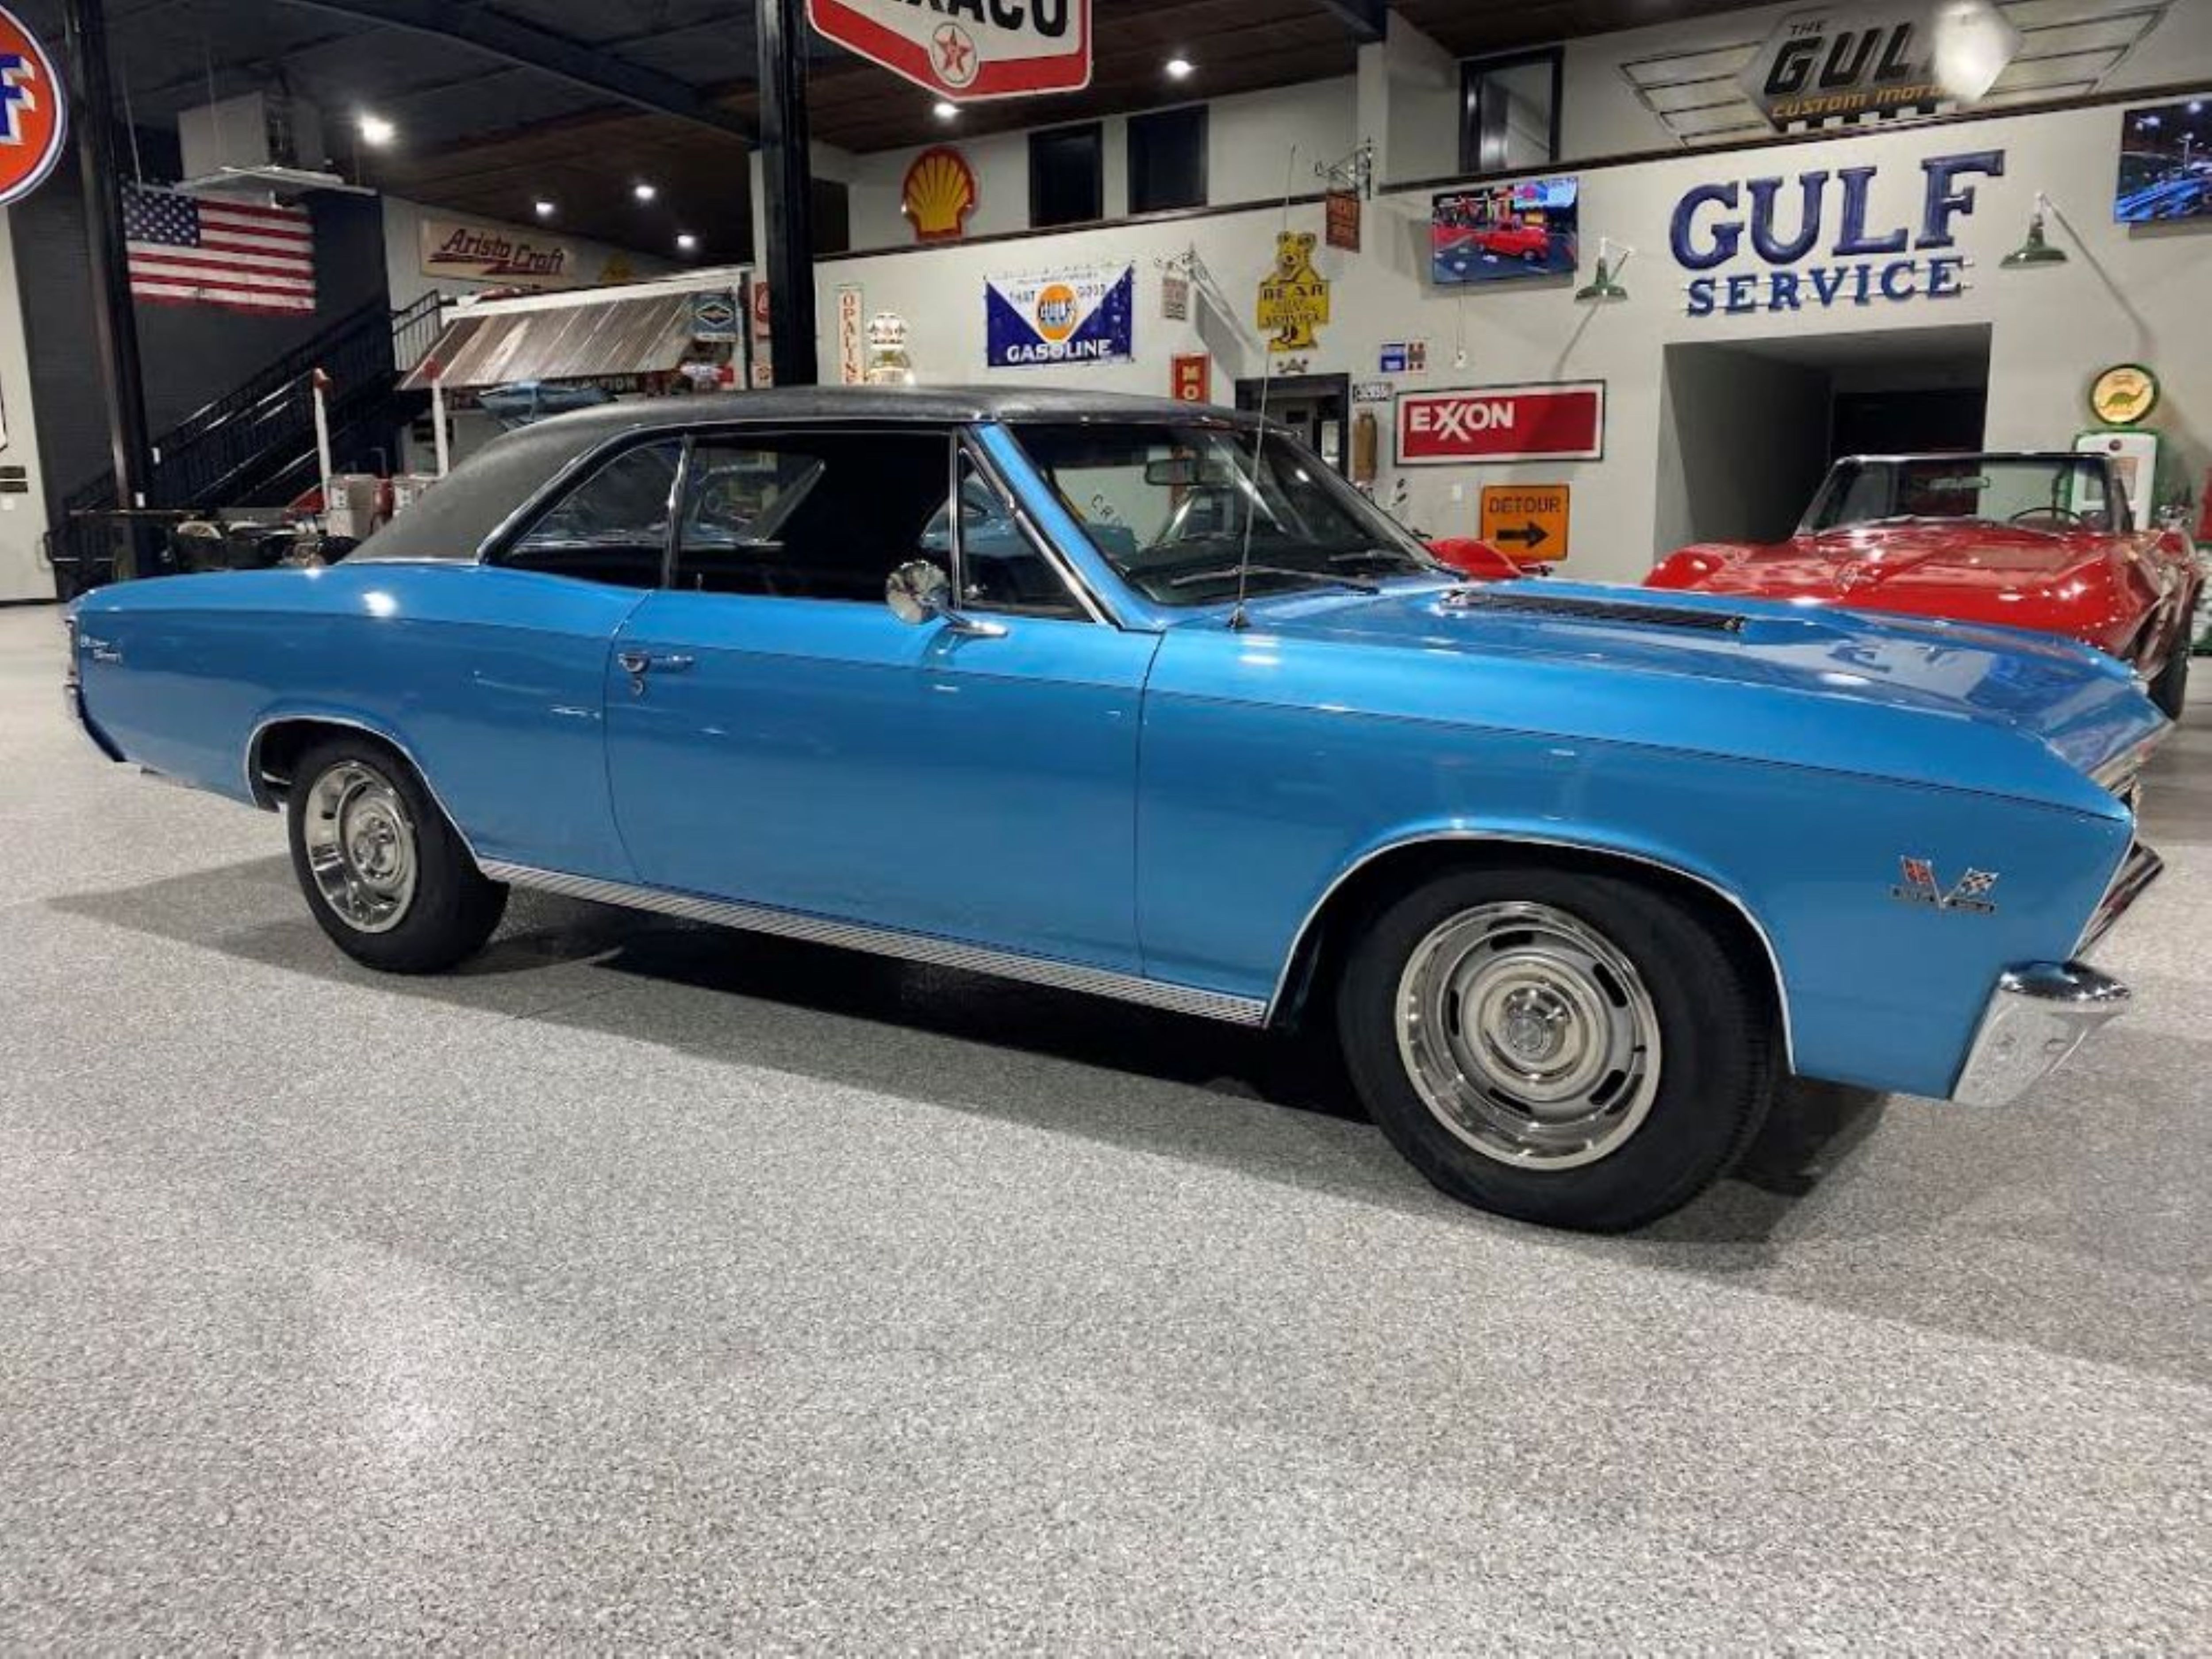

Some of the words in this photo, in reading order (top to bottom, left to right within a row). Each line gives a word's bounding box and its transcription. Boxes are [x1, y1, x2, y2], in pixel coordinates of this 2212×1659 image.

[1790, 21, 1827, 35] THE
[1764, 22, 1935, 94] GUL
[1670, 150, 2005, 271] GULF
[441, 228, 511, 258] Aristo
[512, 244, 565, 274] Craft
[1687, 255, 1964, 317] SERVICE
[1038, 298, 1075, 324] GULF
[1006, 338, 1112, 362] GASOLINE
[1409, 400, 1515, 442] EXXON
[1490, 495, 1561, 513] DETOUR
